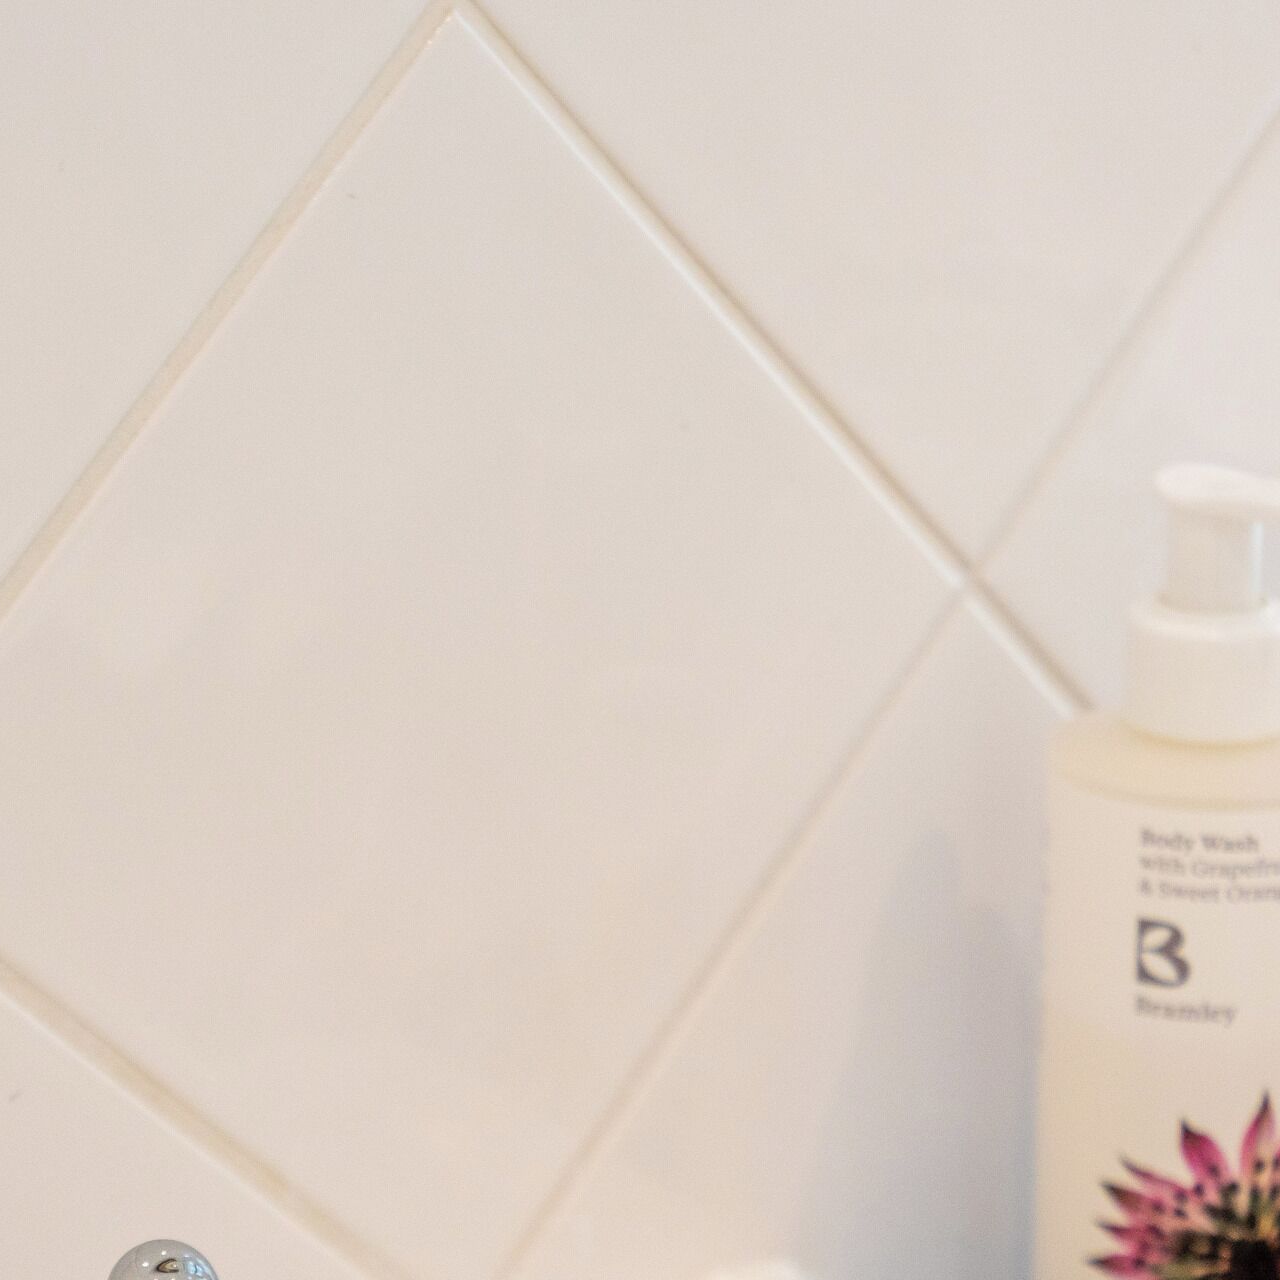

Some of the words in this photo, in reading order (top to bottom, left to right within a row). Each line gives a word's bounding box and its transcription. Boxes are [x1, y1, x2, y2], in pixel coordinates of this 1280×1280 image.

[1140, 828, 1195, 854] Body
[1201, 833, 1260, 852] Wash
[1138, 855, 1185, 876] with
[1158, 881, 1220, 902] Sweet
[1135, 915, 1192, 988] B
[1135, 995, 1239, 1028] Bramley
